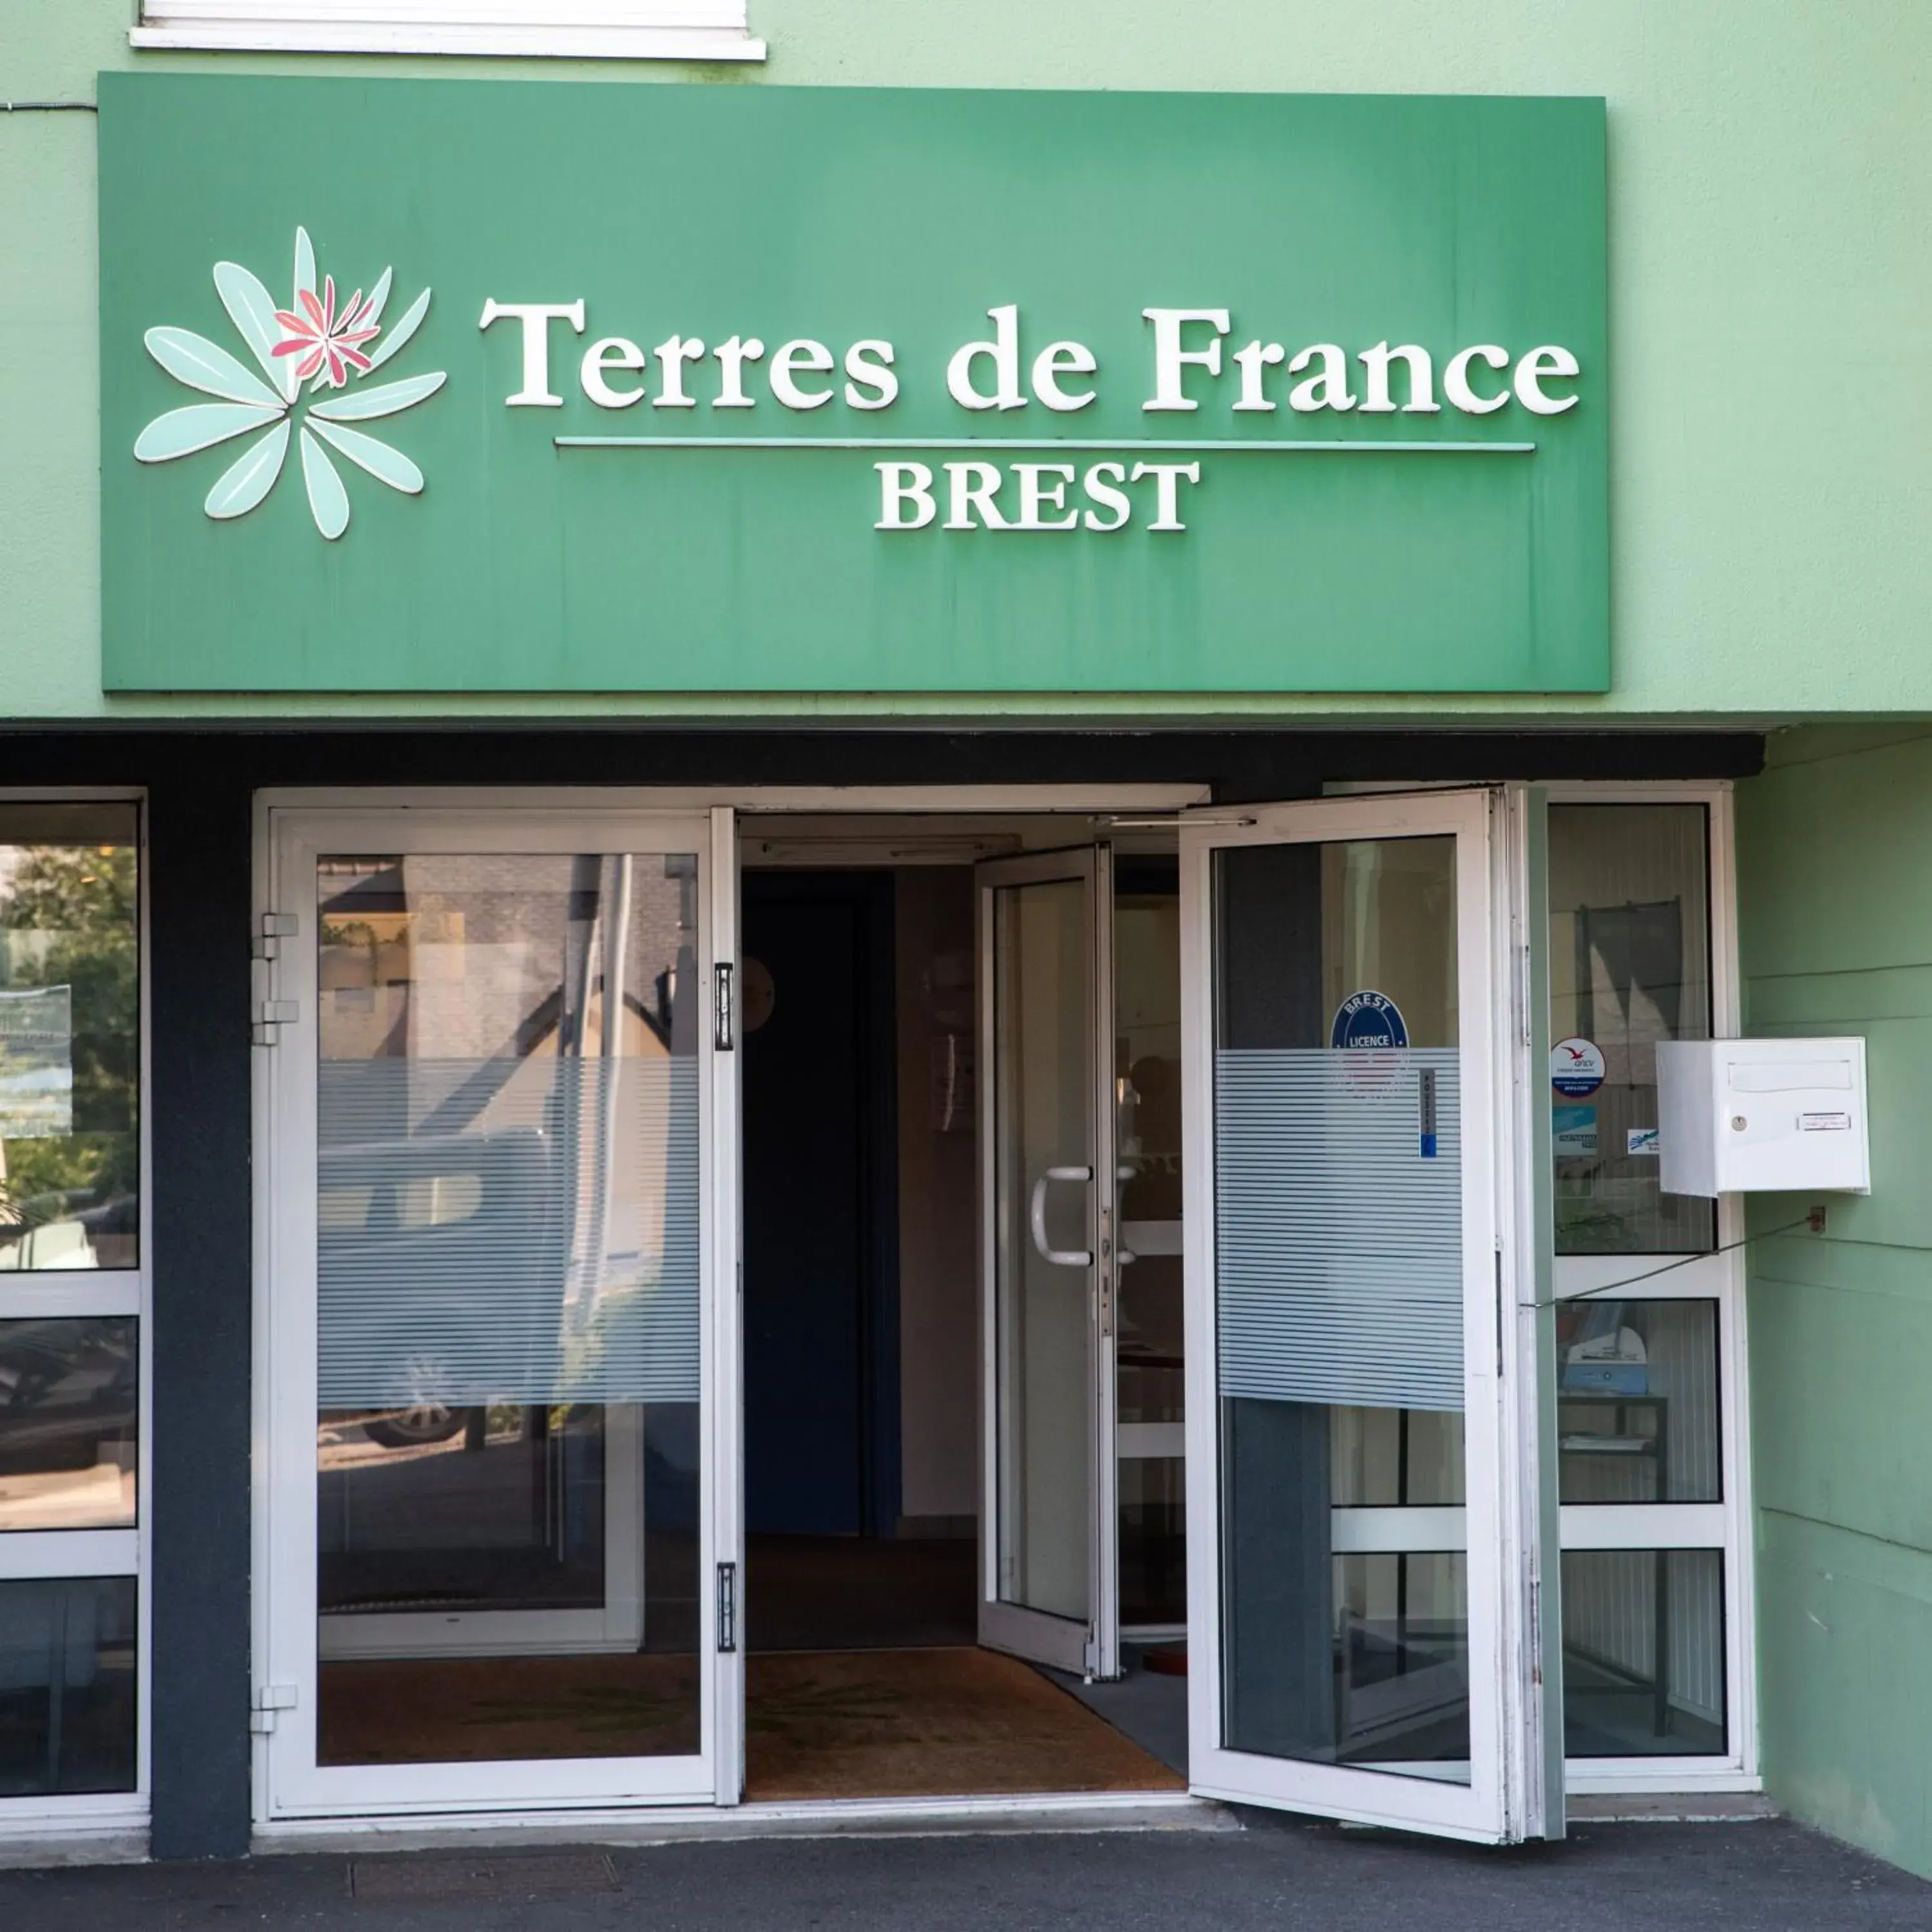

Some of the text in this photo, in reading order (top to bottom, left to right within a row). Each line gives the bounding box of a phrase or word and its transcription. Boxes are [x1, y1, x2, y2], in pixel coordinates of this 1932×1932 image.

[478, 297, 1580, 415] Terres de France
[873, 461, 1200, 531] BREST
[1343, 994, 1391, 1016] BREST
[1349, 1034, 1390, 1048] LICENCE
